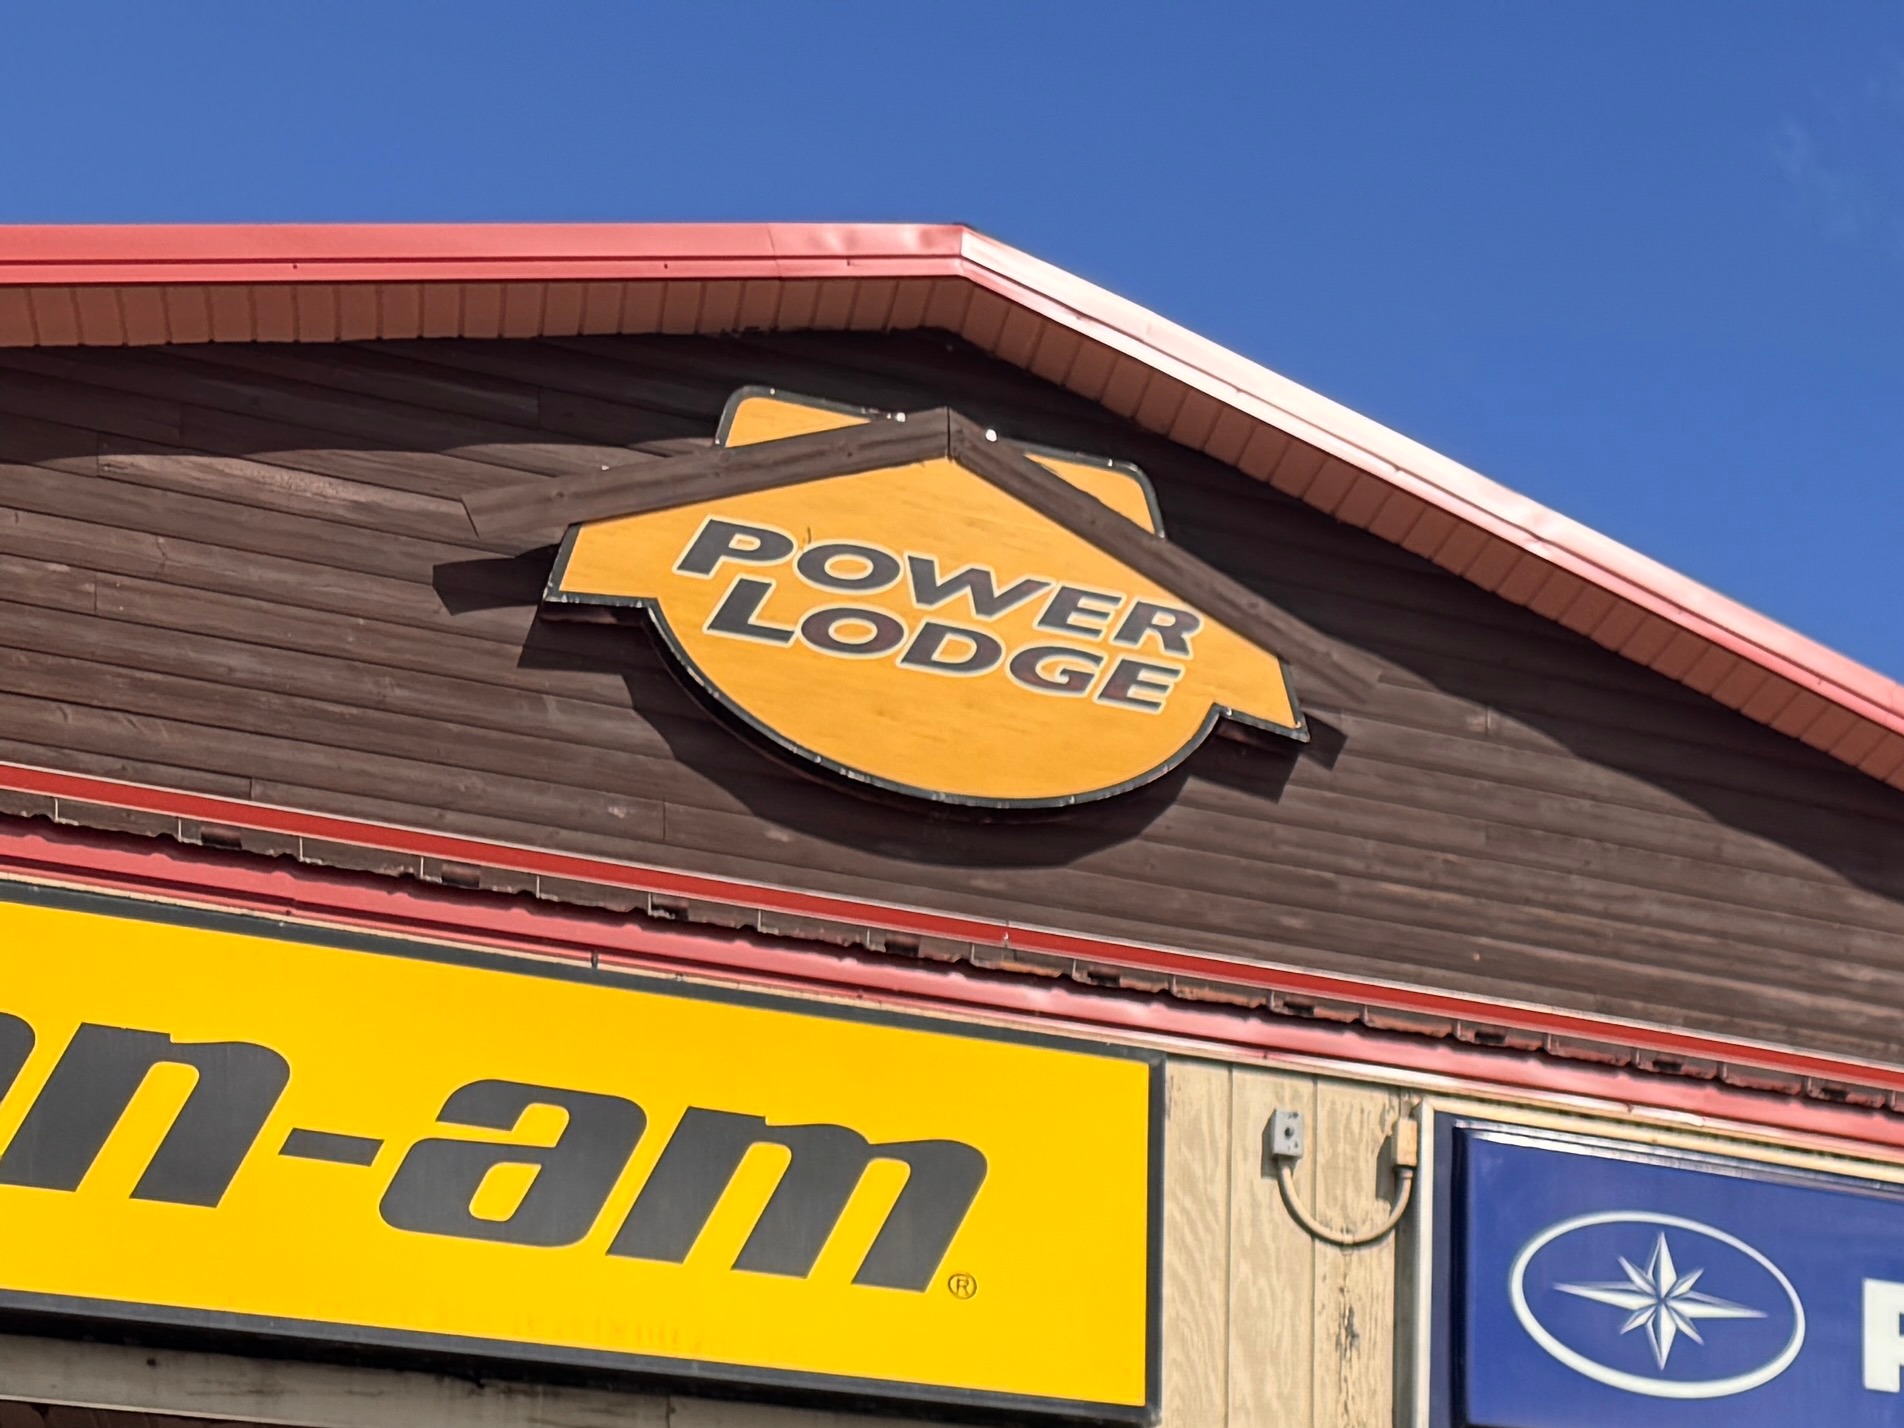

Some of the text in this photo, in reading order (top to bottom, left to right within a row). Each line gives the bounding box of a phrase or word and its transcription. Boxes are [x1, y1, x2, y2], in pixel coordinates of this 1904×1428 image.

[673, 516, 1205, 661] POWER
[704, 575, 1187, 714] LODGE
[0, 1010, 989, 1294] n-am
